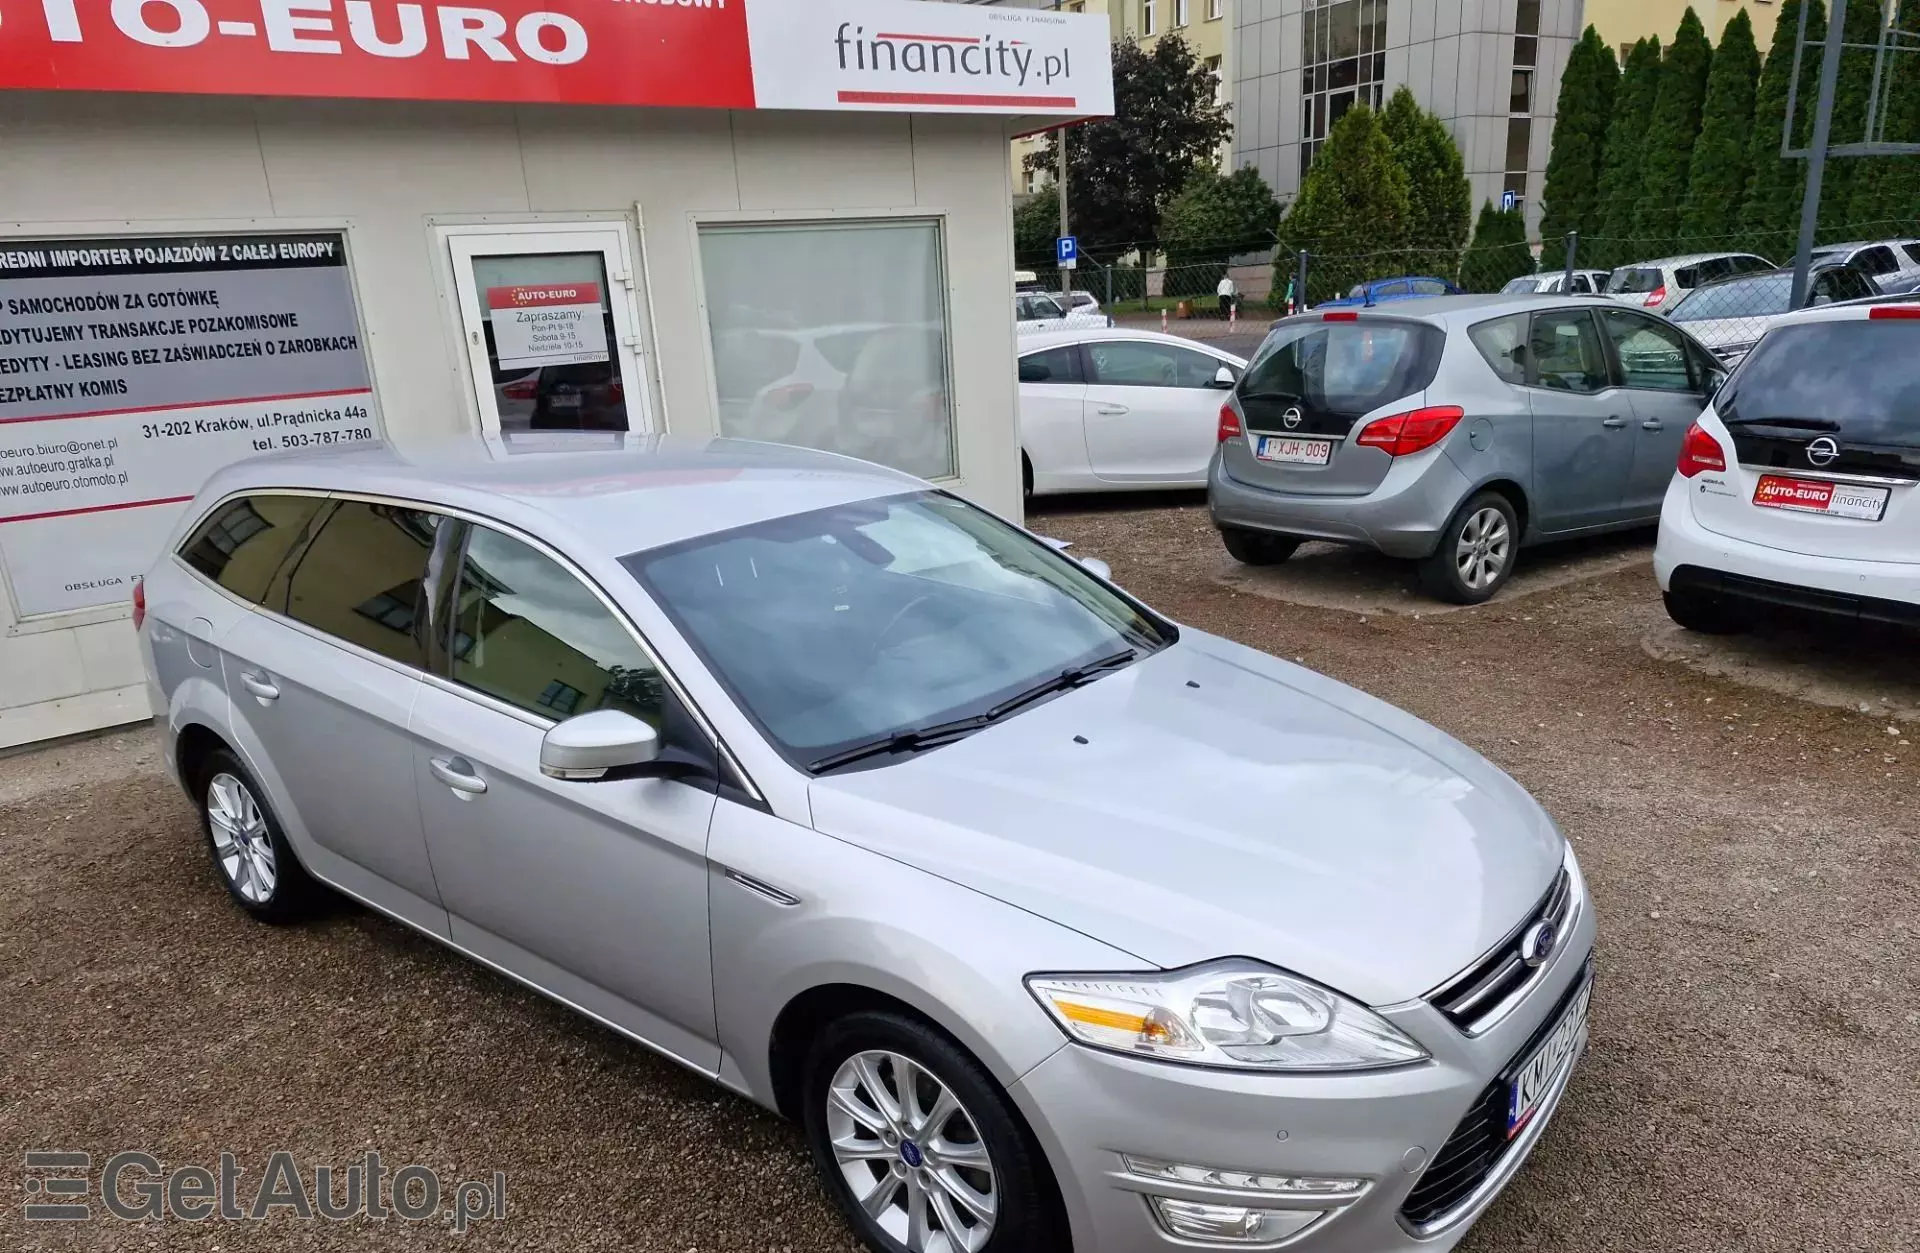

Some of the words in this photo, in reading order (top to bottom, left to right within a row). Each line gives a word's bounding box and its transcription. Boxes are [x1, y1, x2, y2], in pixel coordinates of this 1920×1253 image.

[834, 23, 1070, 86] financity.pl
[50, 248, 132, 267] IMPORTER
[134, 242, 216, 264] POJAZDÓW
[219, 245, 230, 261] Z
[232, 244, 277, 261] CAŁEJ
[279, 242, 334, 259] EUROPY
[1061, 239, 1073, 257] P
[8, 291, 120, 316] SAMOCHODÓW
[123, 293, 144, 310] ZA
[147, 287, 220, 310] GOTÓWKĘ
[518, 290, 576, 300] AUTO-EURO
[0, 325, 84, 346] DYTUJEMY
[88, 320, 186, 341] TRANSAKCJE
[188, 313, 299, 334] POZAKOMISOWE
[531, 324, 557, 332] Pon-Pt
[559, 322, 574, 331] 9-18
[532, 333, 559, 343] Sobota
[560, 331, 576, 340] 9-15
[0, 356, 49, 375] EDYTY
[63, 351, 129, 371] LEASING
[131, 348, 162, 366] BEZ
[163, 339, 262, 364] ZAŚWIADCZEŃ
[265, 340, 276, 356] O
[278, 335, 359, 356] ZAROBKACH
[528, 343, 562, 353] Niedziela
[563, 341, 584, 350] 10-15
[78, 379, 128, 397] KOMIS
[142, 421, 192, 439] 31-202
[195, 416, 254, 434] Kraków,
[257, 410, 341, 428] ul.Prądnicka
[344, 405, 368, 419] 44a
[0, 437, 118, 459] oeuro.biuro@onet.pl
[252, 438, 277, 451] tel.
[281, 427, 372, 449] 503-787-780
[1763, 485, 1829, 501] AUTO-EURO
[64, 577, 123, 592] OBSŁUGA
